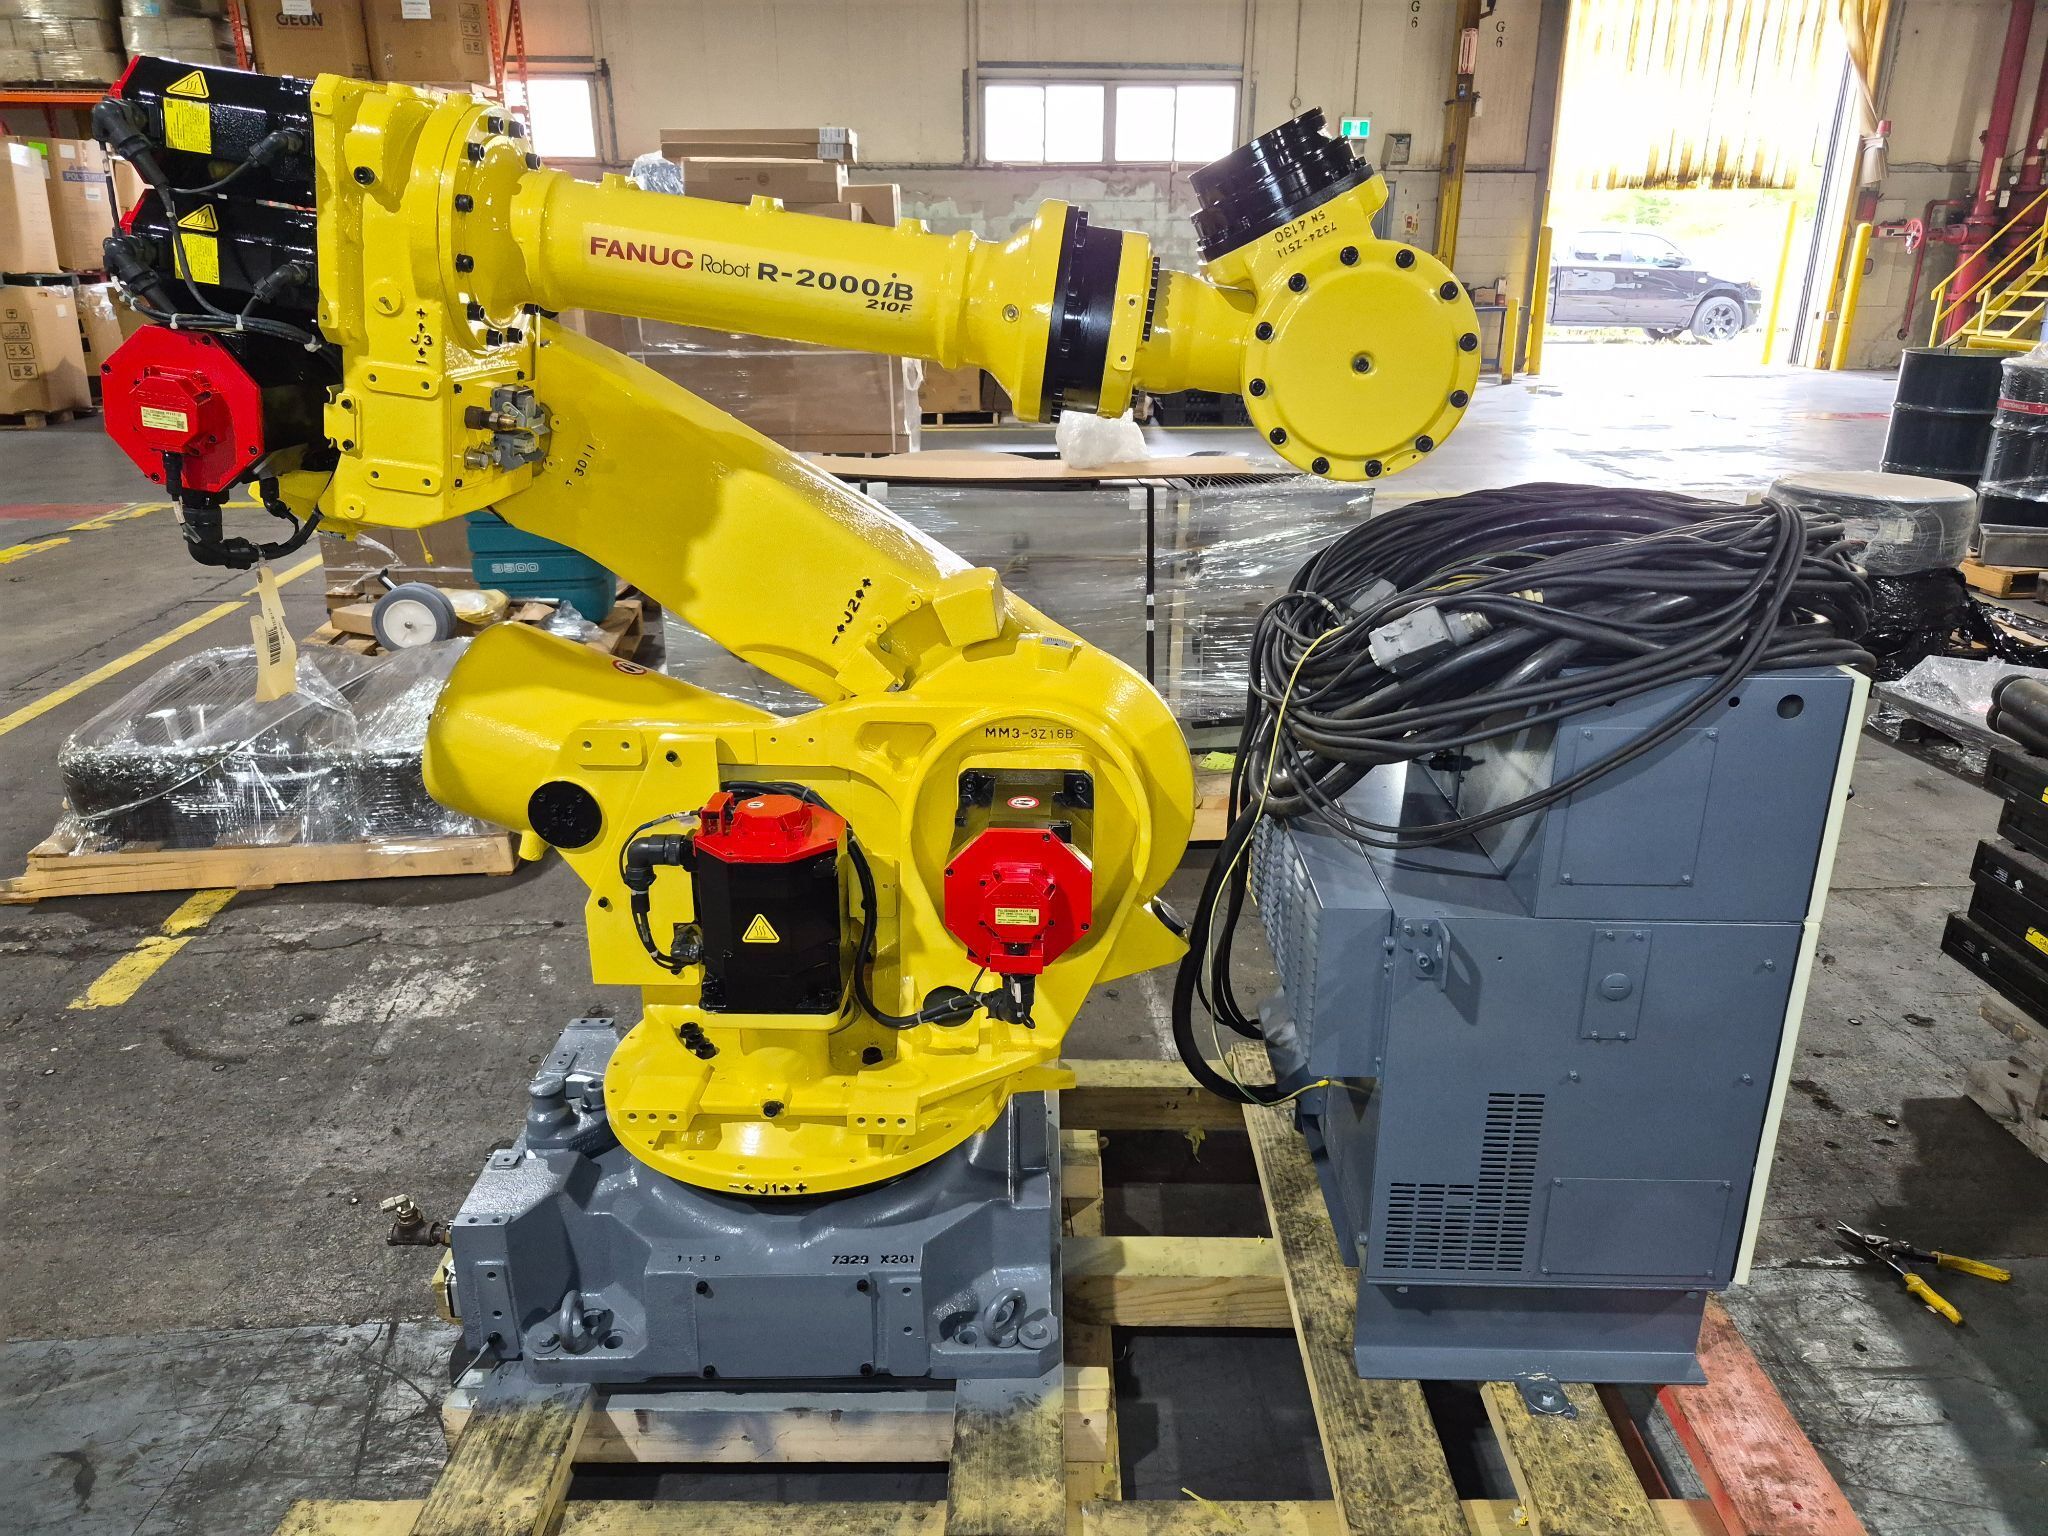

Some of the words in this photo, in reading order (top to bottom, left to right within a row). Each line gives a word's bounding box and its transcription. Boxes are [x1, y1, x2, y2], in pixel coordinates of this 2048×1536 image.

[1410, 0, 1421, 13] G
[276, 11, 323, 26] GEON
[1411, 17, 1419, 29] 6
[1495, 21, 1506, 33] G
[1495, 36, 1503, 48] 6
[1274, 219, 1306, 243] 4130
[590, 236, 694, 270] FANUC
[700, 253, 751, 278] Robot
[757, 262, 914, 302] R-2000iB
[865, 299, 913, 314] 210F
[491, 562, 539, 574] 3500
[880, 1254, 915, 1264] X201
